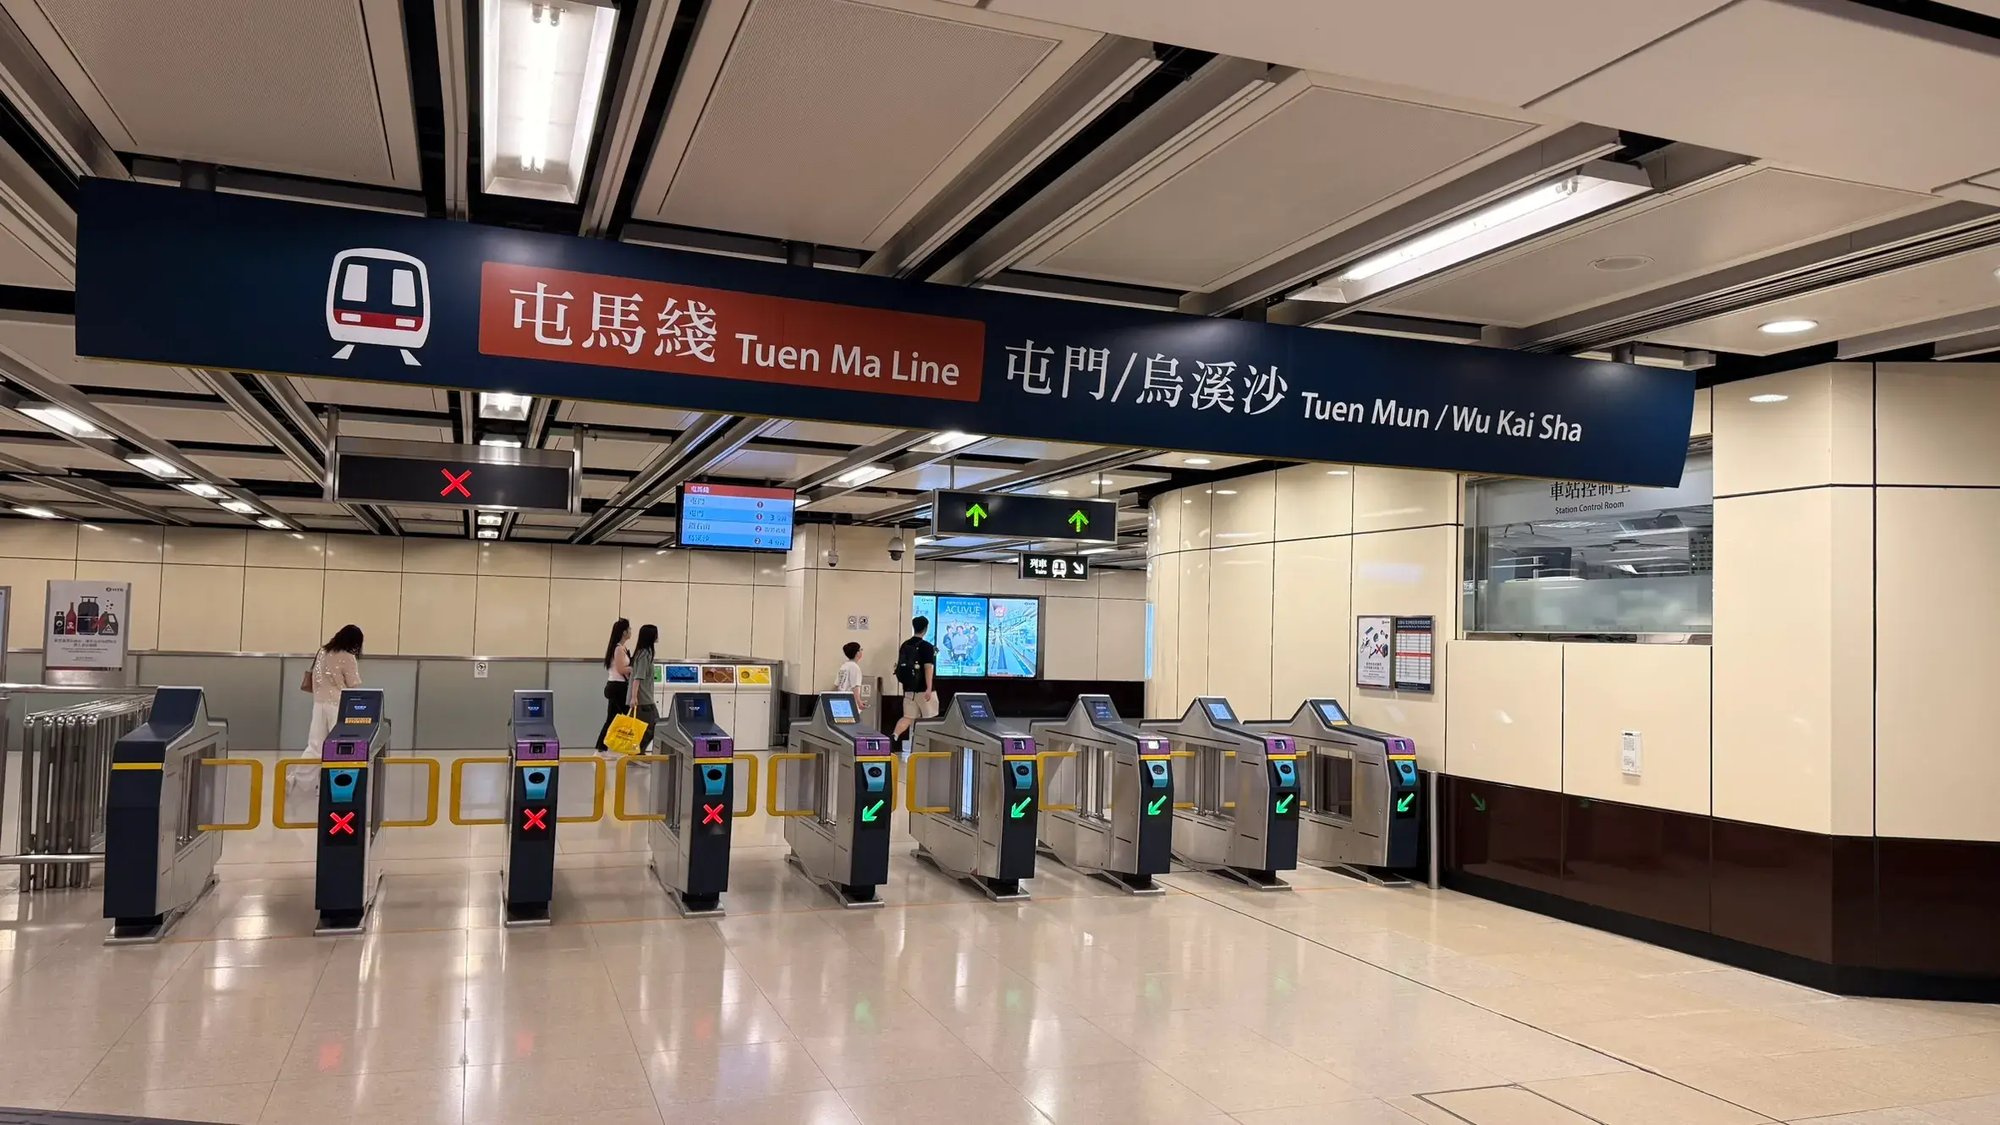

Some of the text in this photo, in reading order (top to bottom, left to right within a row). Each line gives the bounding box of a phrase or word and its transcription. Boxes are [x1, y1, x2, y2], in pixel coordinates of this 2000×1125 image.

[510, 282, 717, 363] 屯馬綫
[736, 334, 960, 386] Tuen Ma Line
[1005, 339, 1288, 415] 屯門/烏溪沙
[1301, 392, 1363, 423] Tuen
[1371, 399, 1430, 429] Mun
[1453, 405, 1491, 434] Wu
[1497, 410, 1535, 438] Kai
[1539, 414, 1582, 442] Sha
[1555, 501, 1625, 515] Station Control Room
[945, 605, 981, 615] ACUVUE
